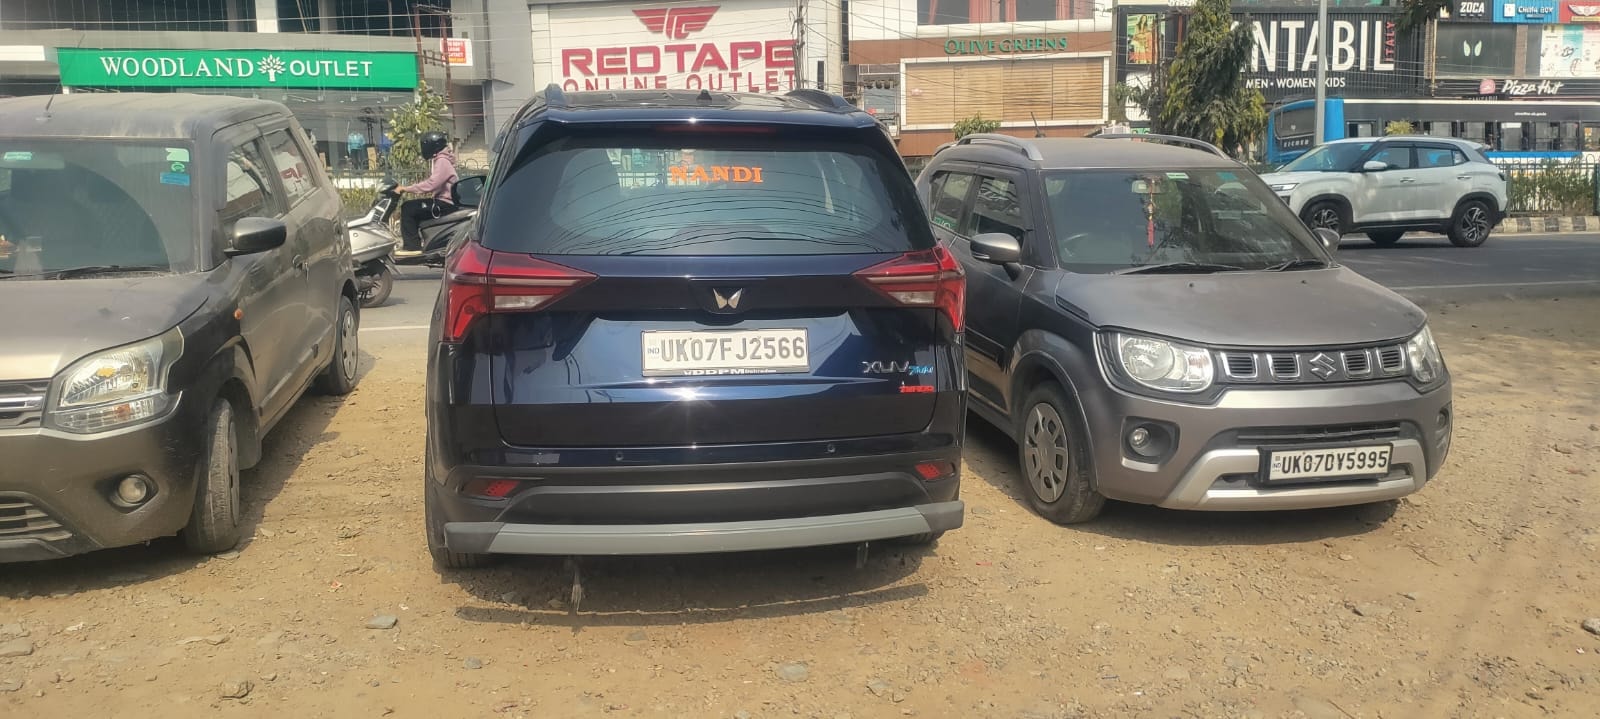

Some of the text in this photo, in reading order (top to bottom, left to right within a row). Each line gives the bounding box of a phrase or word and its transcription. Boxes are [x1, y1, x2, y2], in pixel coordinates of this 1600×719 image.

[1460, 2, 1485, 13] ZOCA
[944, 37, 1067, 54] OLIVE GREENS
[1230, 20, 1395, 73] NTABIL
[1385, 21, 1395, 61] ITALY
[100, 56, 373, 78] WOODLAND OUTLET
[1245, 79, 1269, 88] MEN
[1276, 78, 1316, 88] WOMEN
[1501, 79, 1565, 95] Pizza Hut
[668, 164, 764, 183] NANDI
[661, 336, 805, 362] UK07FJ2566
